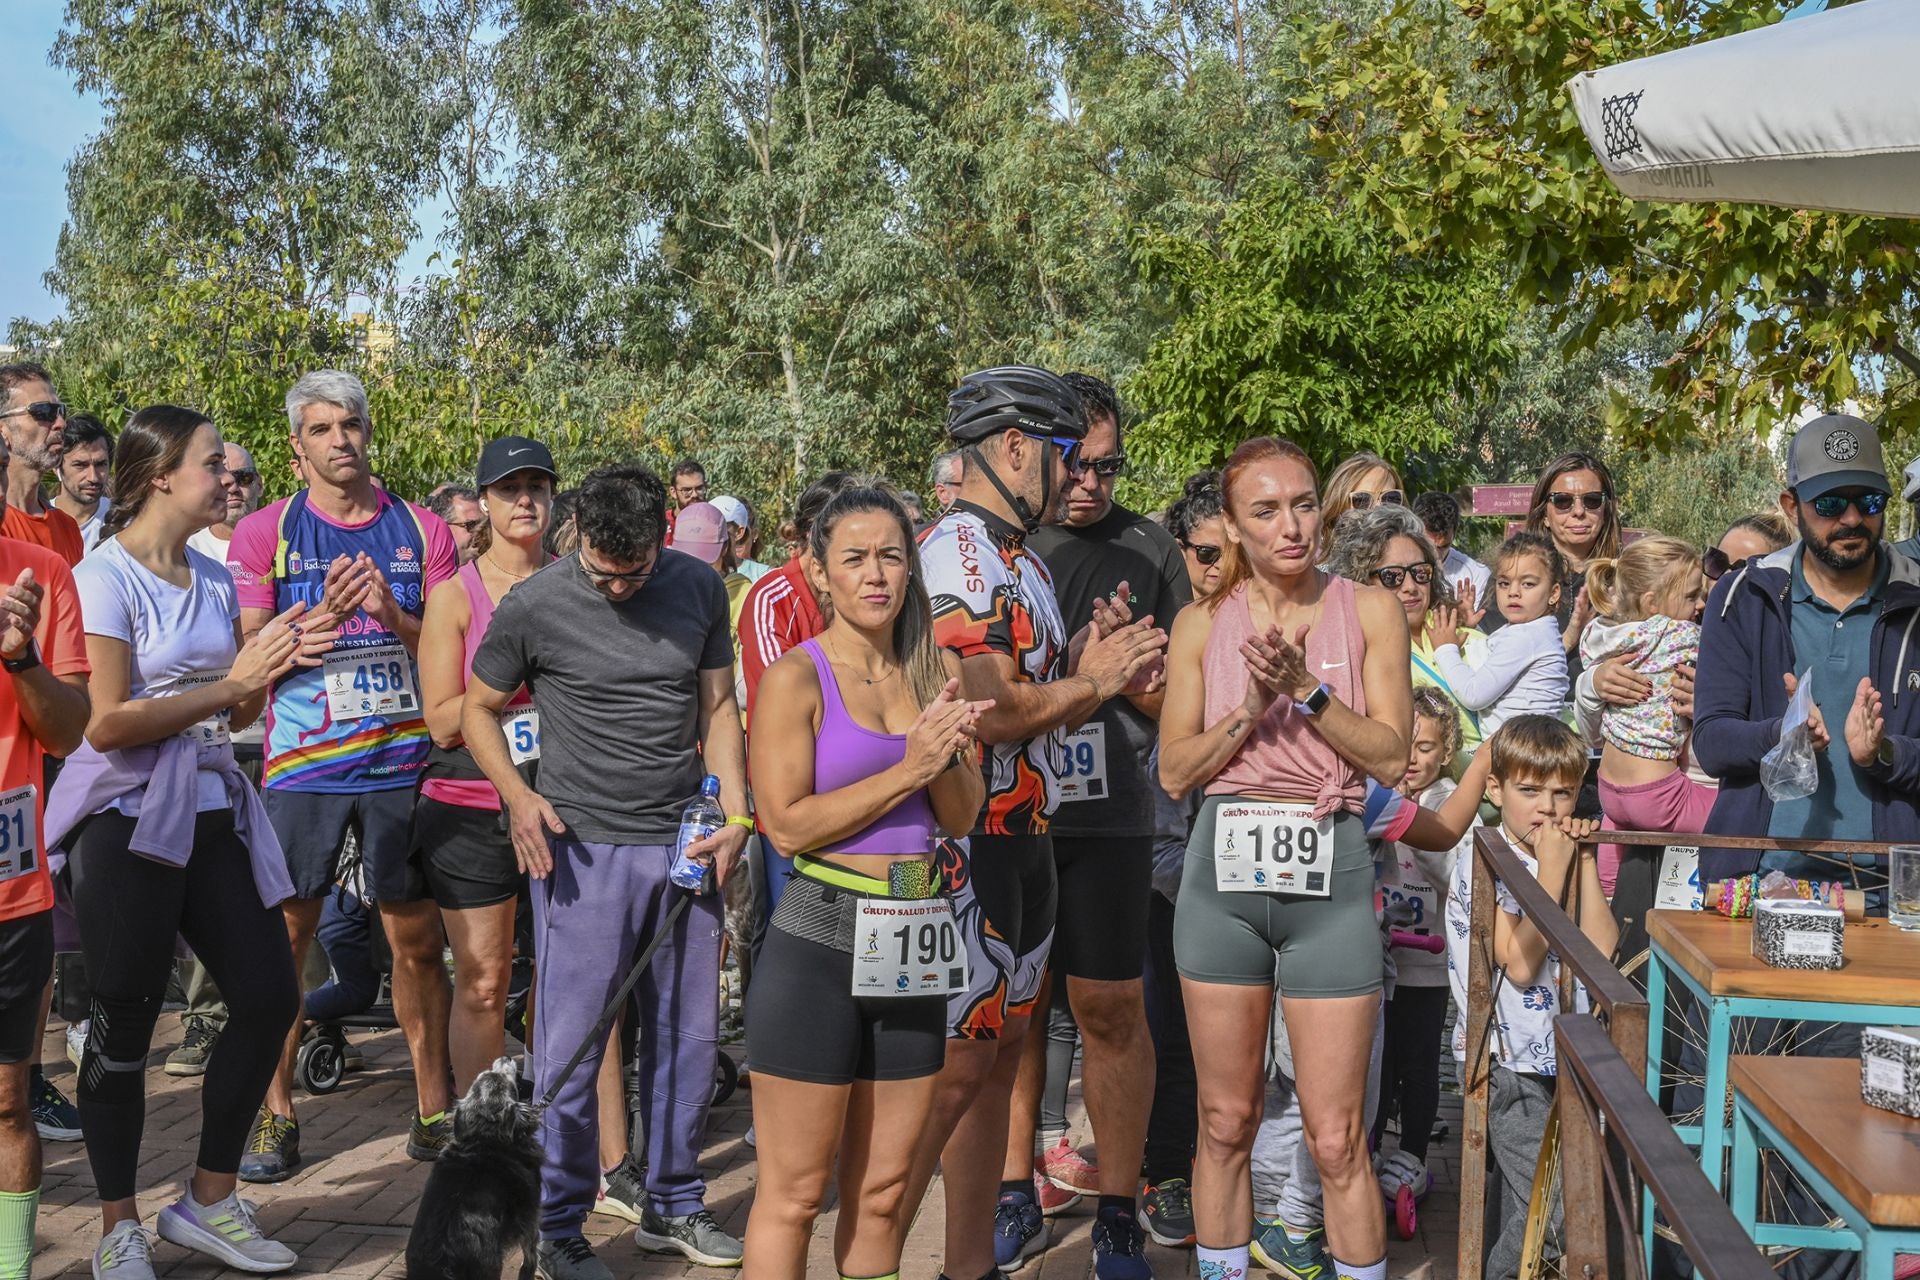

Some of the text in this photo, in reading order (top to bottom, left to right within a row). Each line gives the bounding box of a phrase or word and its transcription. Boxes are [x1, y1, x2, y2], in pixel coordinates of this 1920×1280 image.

[326, 655, 350, 664] GRUPO
[351, 651, 374, 661] SALUD
[380, 648, 404, 657] DEPORTE
[353, 661, 404, 694] 458
[1222, 808, 1249, 817] GRUPO
[1250, 808, 1280, 817] SALUD
[1289, 810, 1314, 819] DEPO
[1247, 824, 1319, 865] 189
[1670, 846, 1694, 854] GRUPO
[1403, 883, 1432, 892] DEPORTE
[863, 906, 896, 915] GRUPO
[897, 906, 925, 916] SALUD
[893, 921, 956, 967] 190
